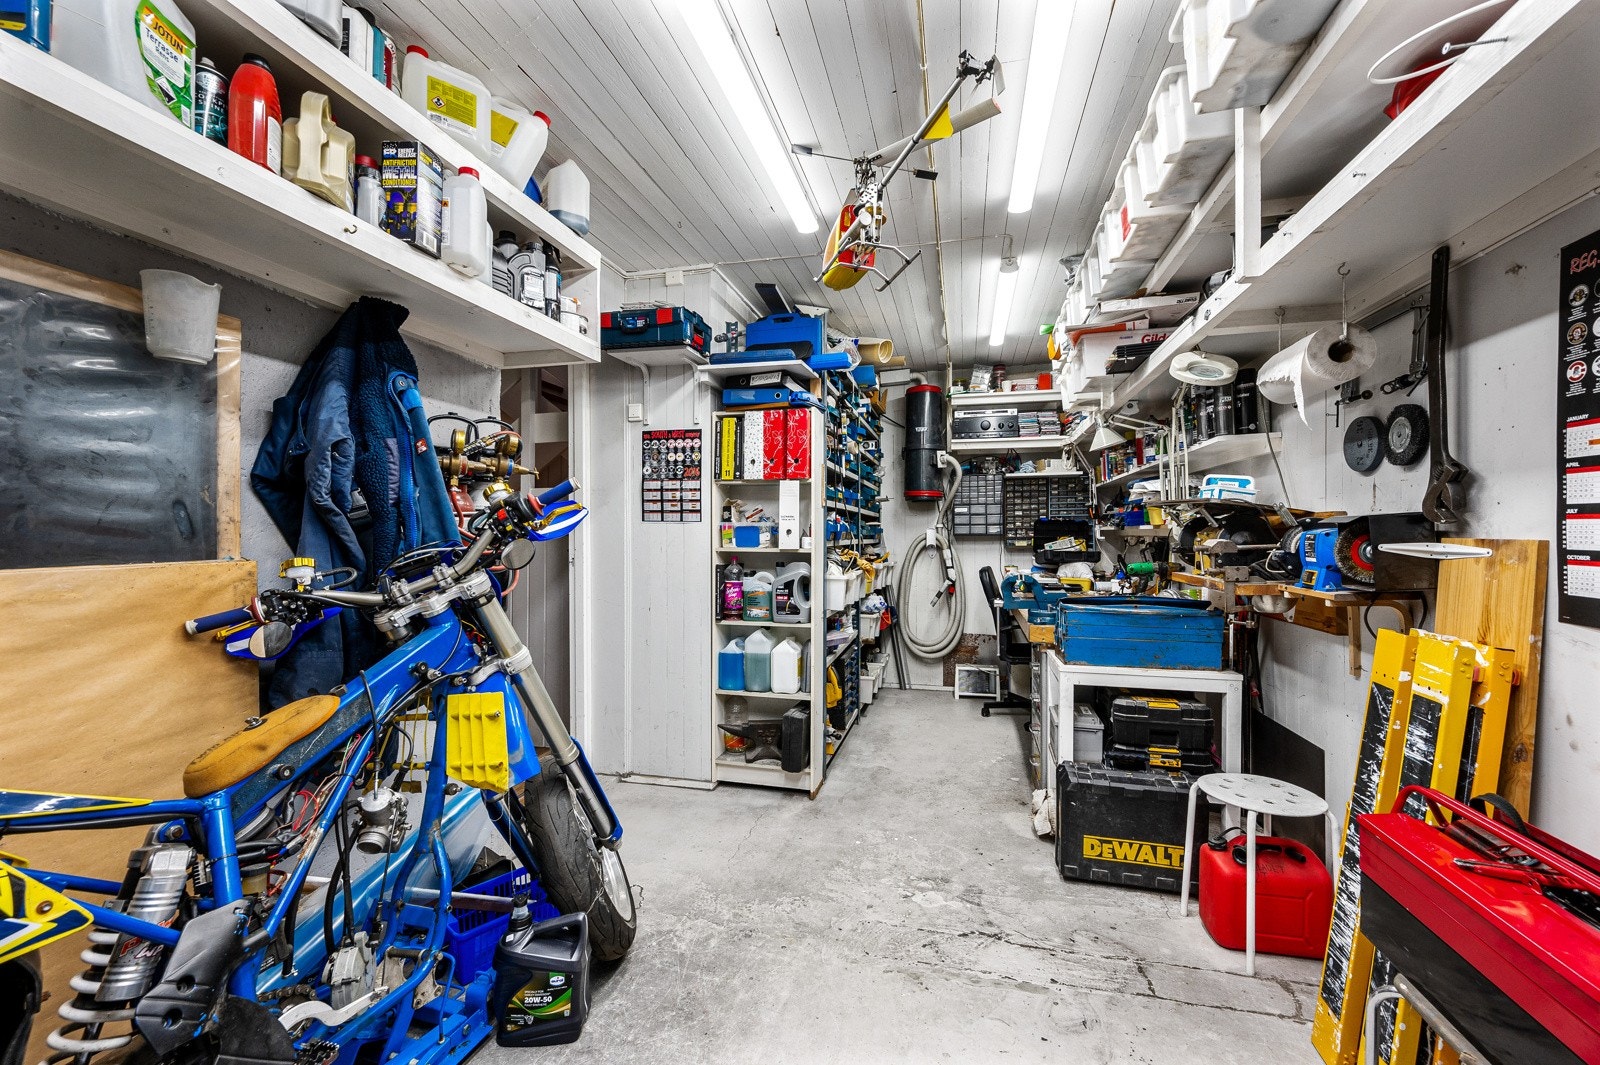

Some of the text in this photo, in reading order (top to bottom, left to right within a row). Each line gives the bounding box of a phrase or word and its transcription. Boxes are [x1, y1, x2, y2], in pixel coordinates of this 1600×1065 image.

[153, 22, 184, 53] JOTUN
[145, 28, 179, 63] Terrasse
[382, 166, 417, 179] METAL
[1141, 333, 1171, 344] Gild
[1566, 413, 1589, 422] JANUARY
